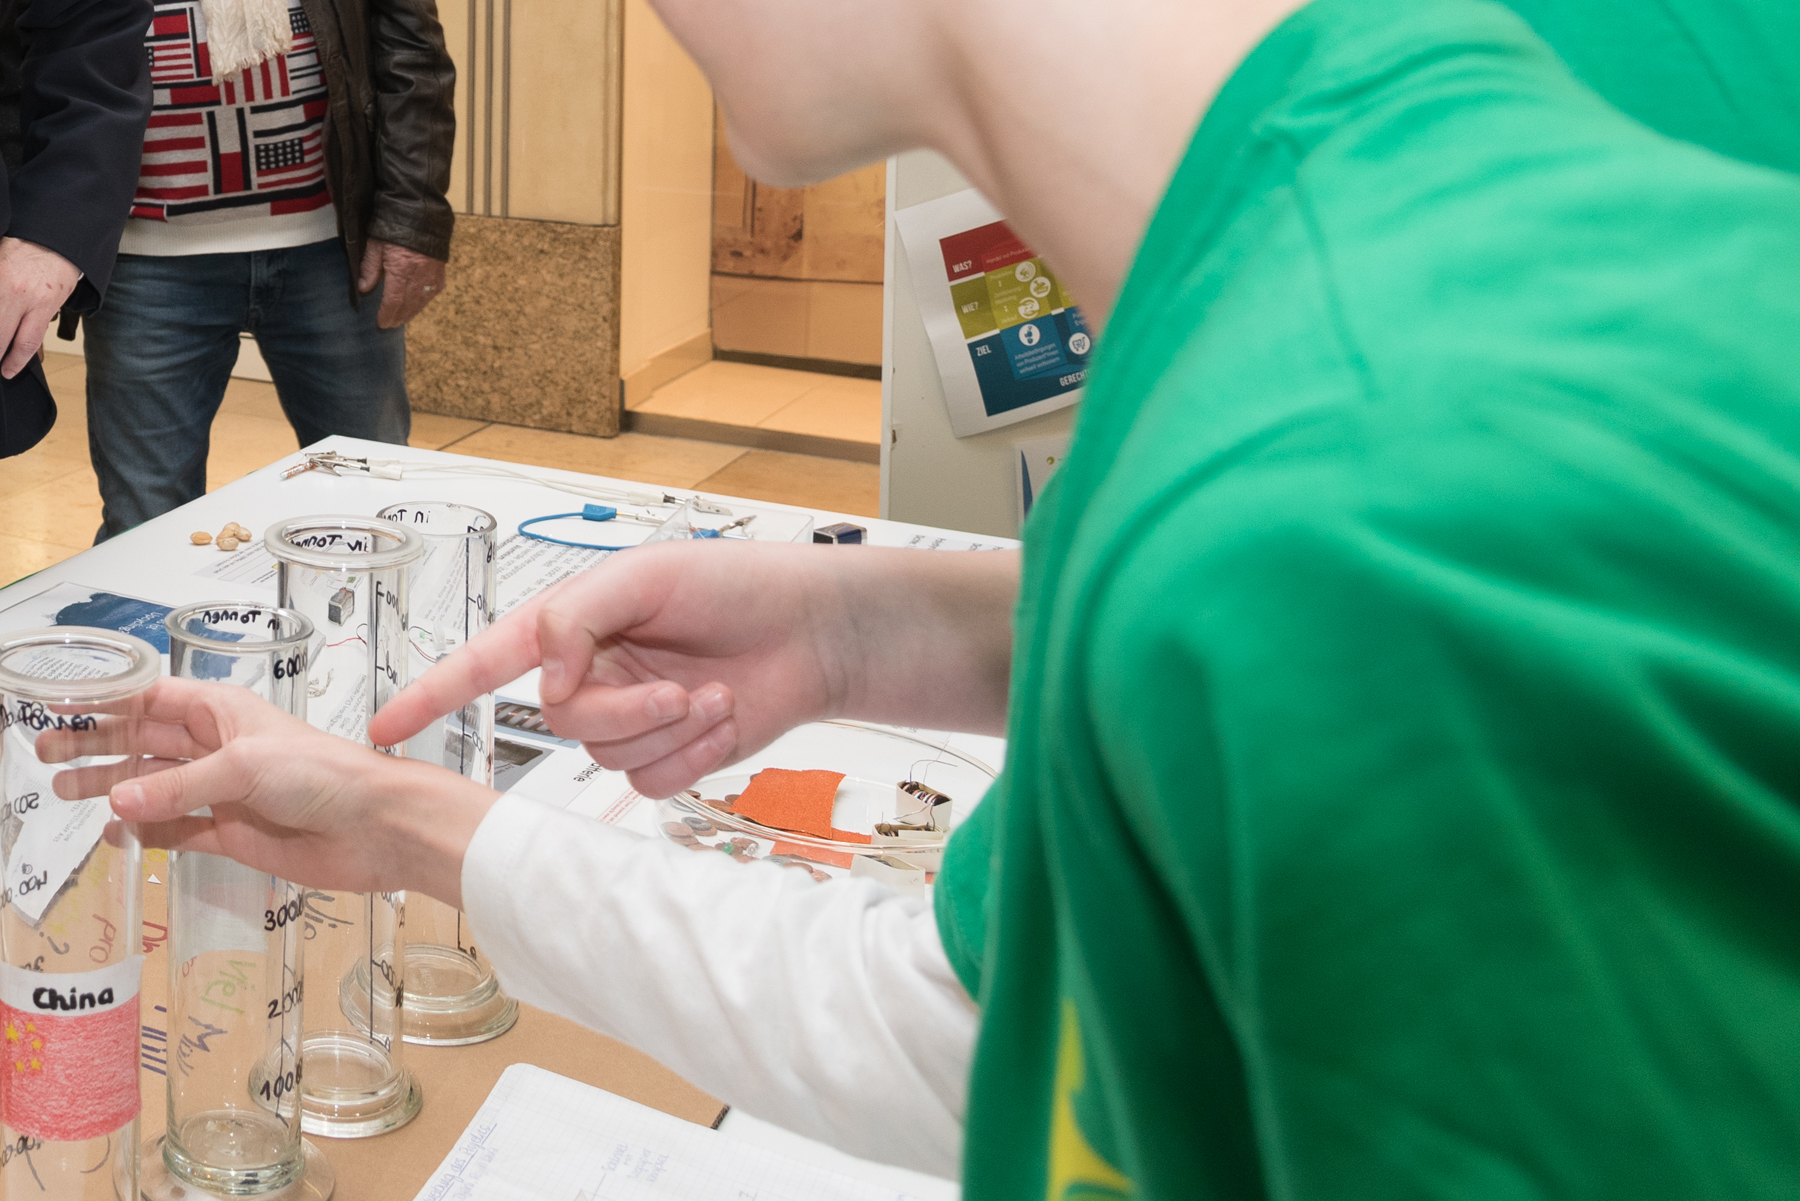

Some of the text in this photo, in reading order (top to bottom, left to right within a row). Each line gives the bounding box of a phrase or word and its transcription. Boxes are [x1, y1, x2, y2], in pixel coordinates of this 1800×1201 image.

[952, 260, 973, 274] WAS?
[961, 301, 979, 314] WIE?
[976, 344, 992, 357] ZIEL
[32, 986, 114, 1011] China
